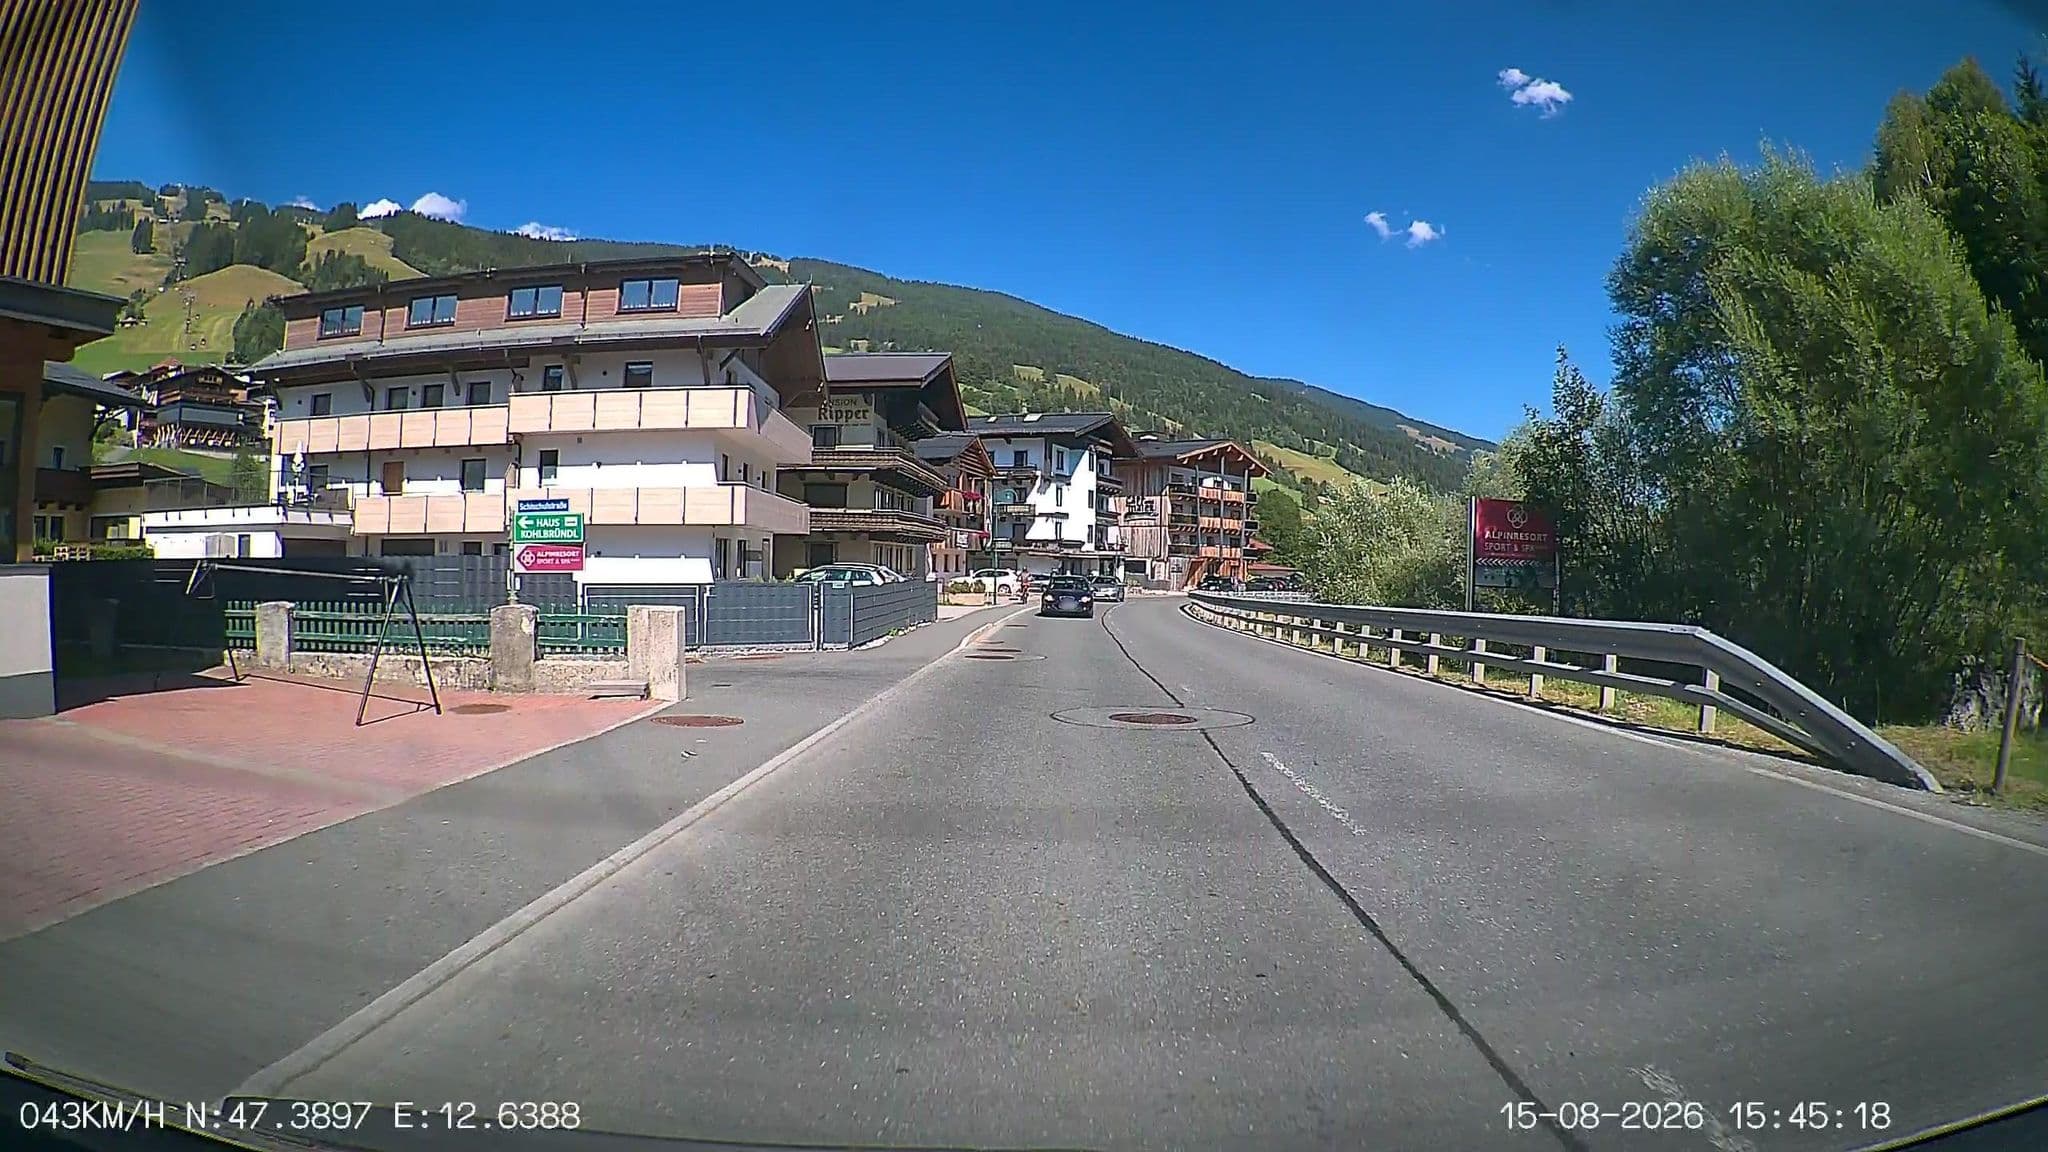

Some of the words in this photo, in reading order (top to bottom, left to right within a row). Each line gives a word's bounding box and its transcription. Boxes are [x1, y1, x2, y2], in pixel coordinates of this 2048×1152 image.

[818, 408, 869, 422] Ripper
[536, 518, 560, 527] HAUS
[520, 528, 579, 538] KOHLBRÜNDL
[1484, 531, 1548, 542] ALPINRESORT
[1484, 543, 1511, 552] SPORT
[1521, 544, 1536, 552] SPA
